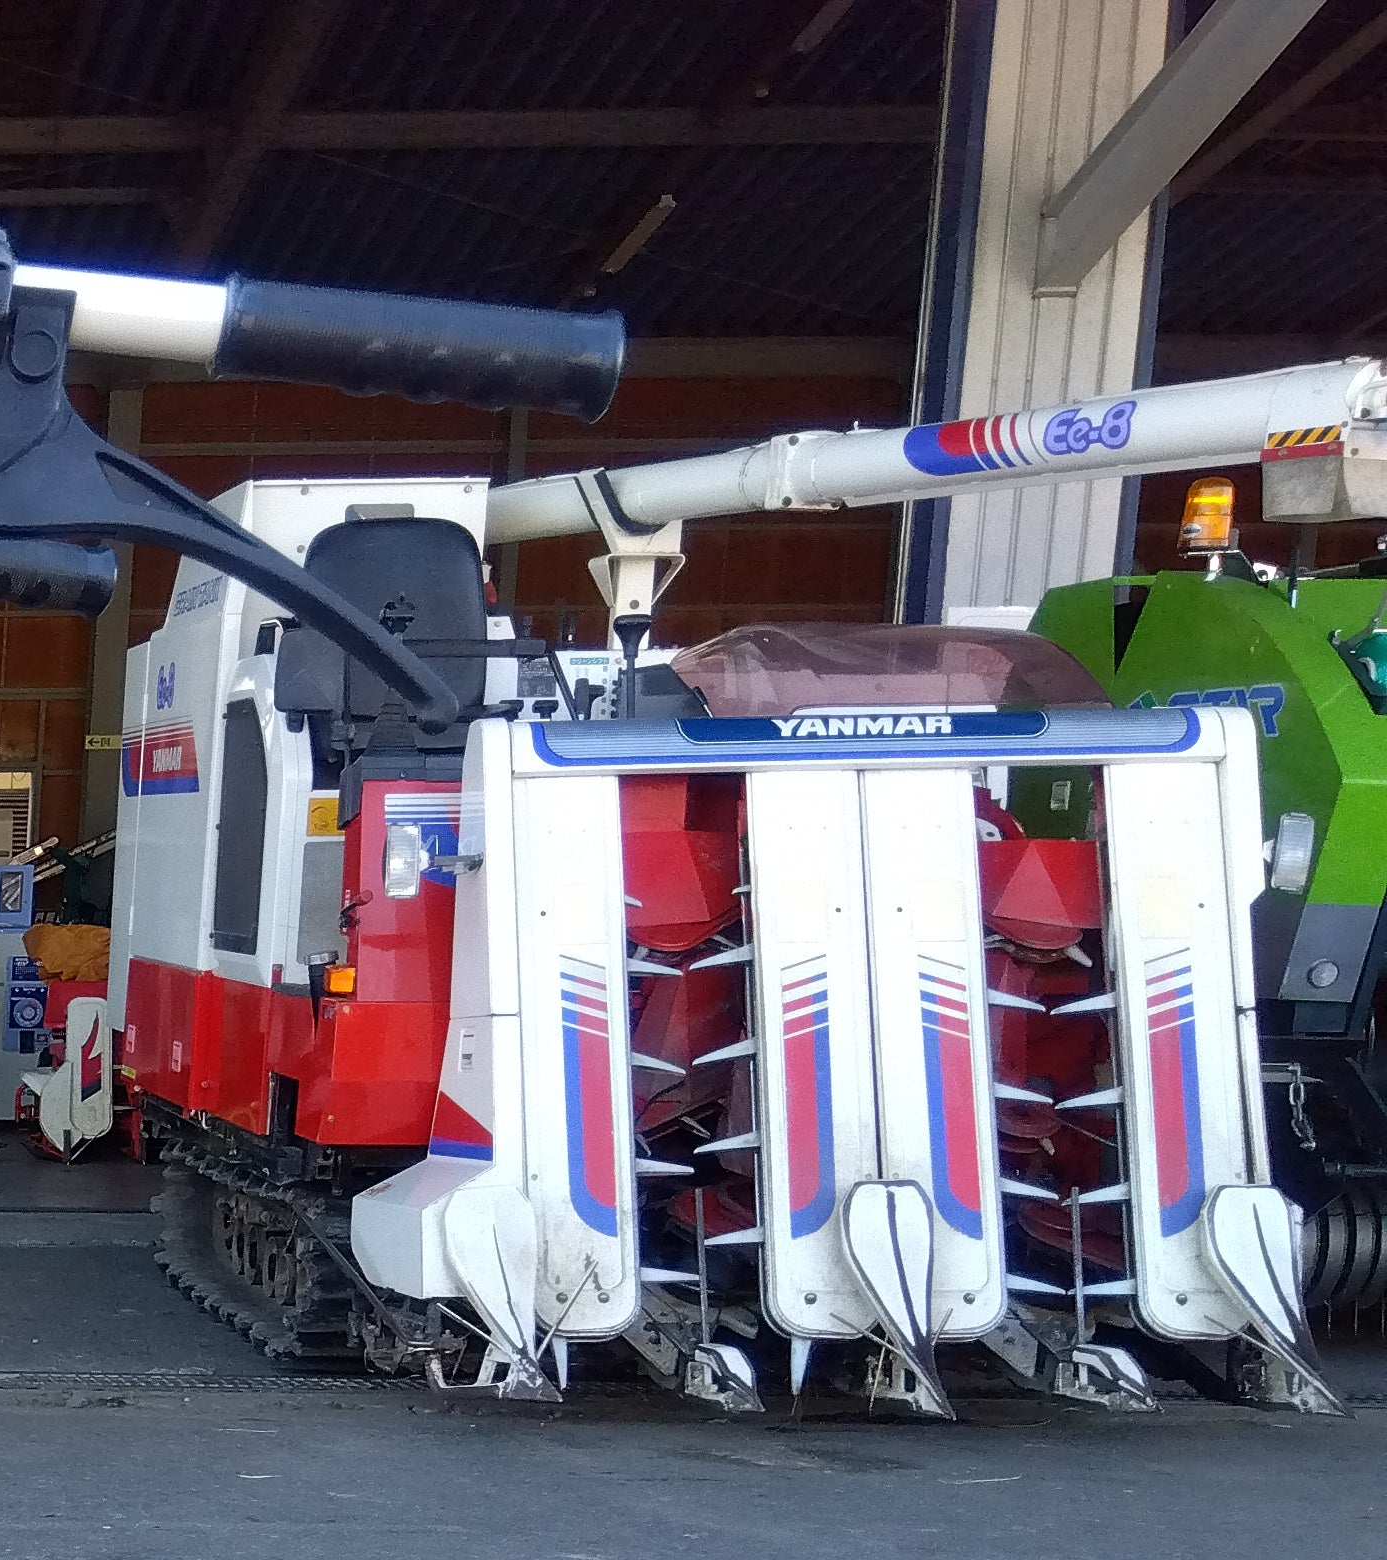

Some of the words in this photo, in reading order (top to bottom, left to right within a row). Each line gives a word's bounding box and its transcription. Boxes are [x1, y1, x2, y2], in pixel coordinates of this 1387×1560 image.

[1043, 400, 1137, 455] Ee-8
[771, 716, 952, 737] YANMAR
[152, 746, 182, 772] YANMAR
